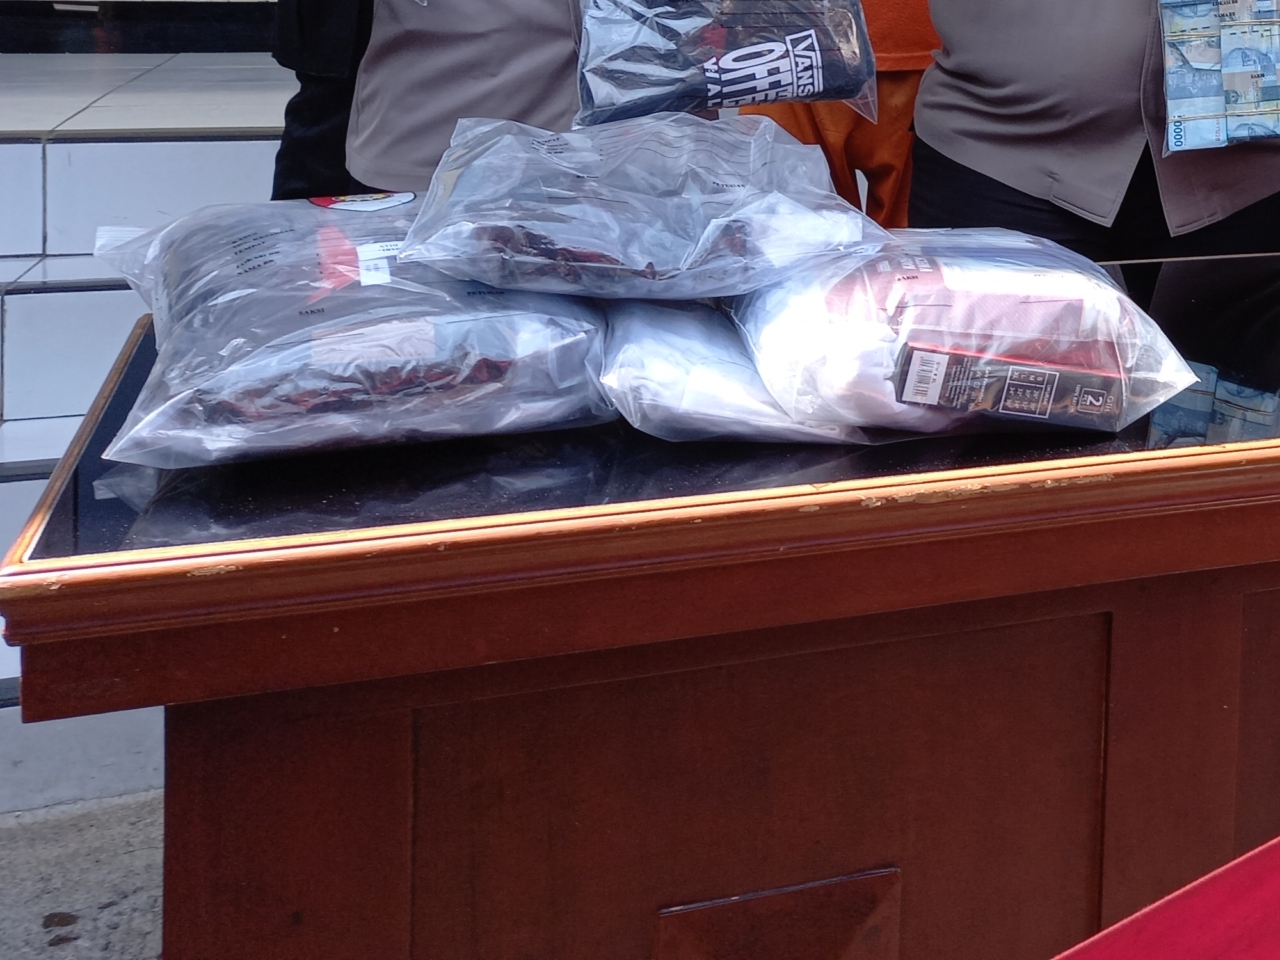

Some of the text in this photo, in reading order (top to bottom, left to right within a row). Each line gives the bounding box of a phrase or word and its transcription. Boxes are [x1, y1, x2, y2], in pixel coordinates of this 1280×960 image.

[718, 41, 793, 94] OFF
[793, 36, 814, 97] VANS
[299, 307, 325, 316] SAKSI
[1086, 394, 1103, 406] 2
